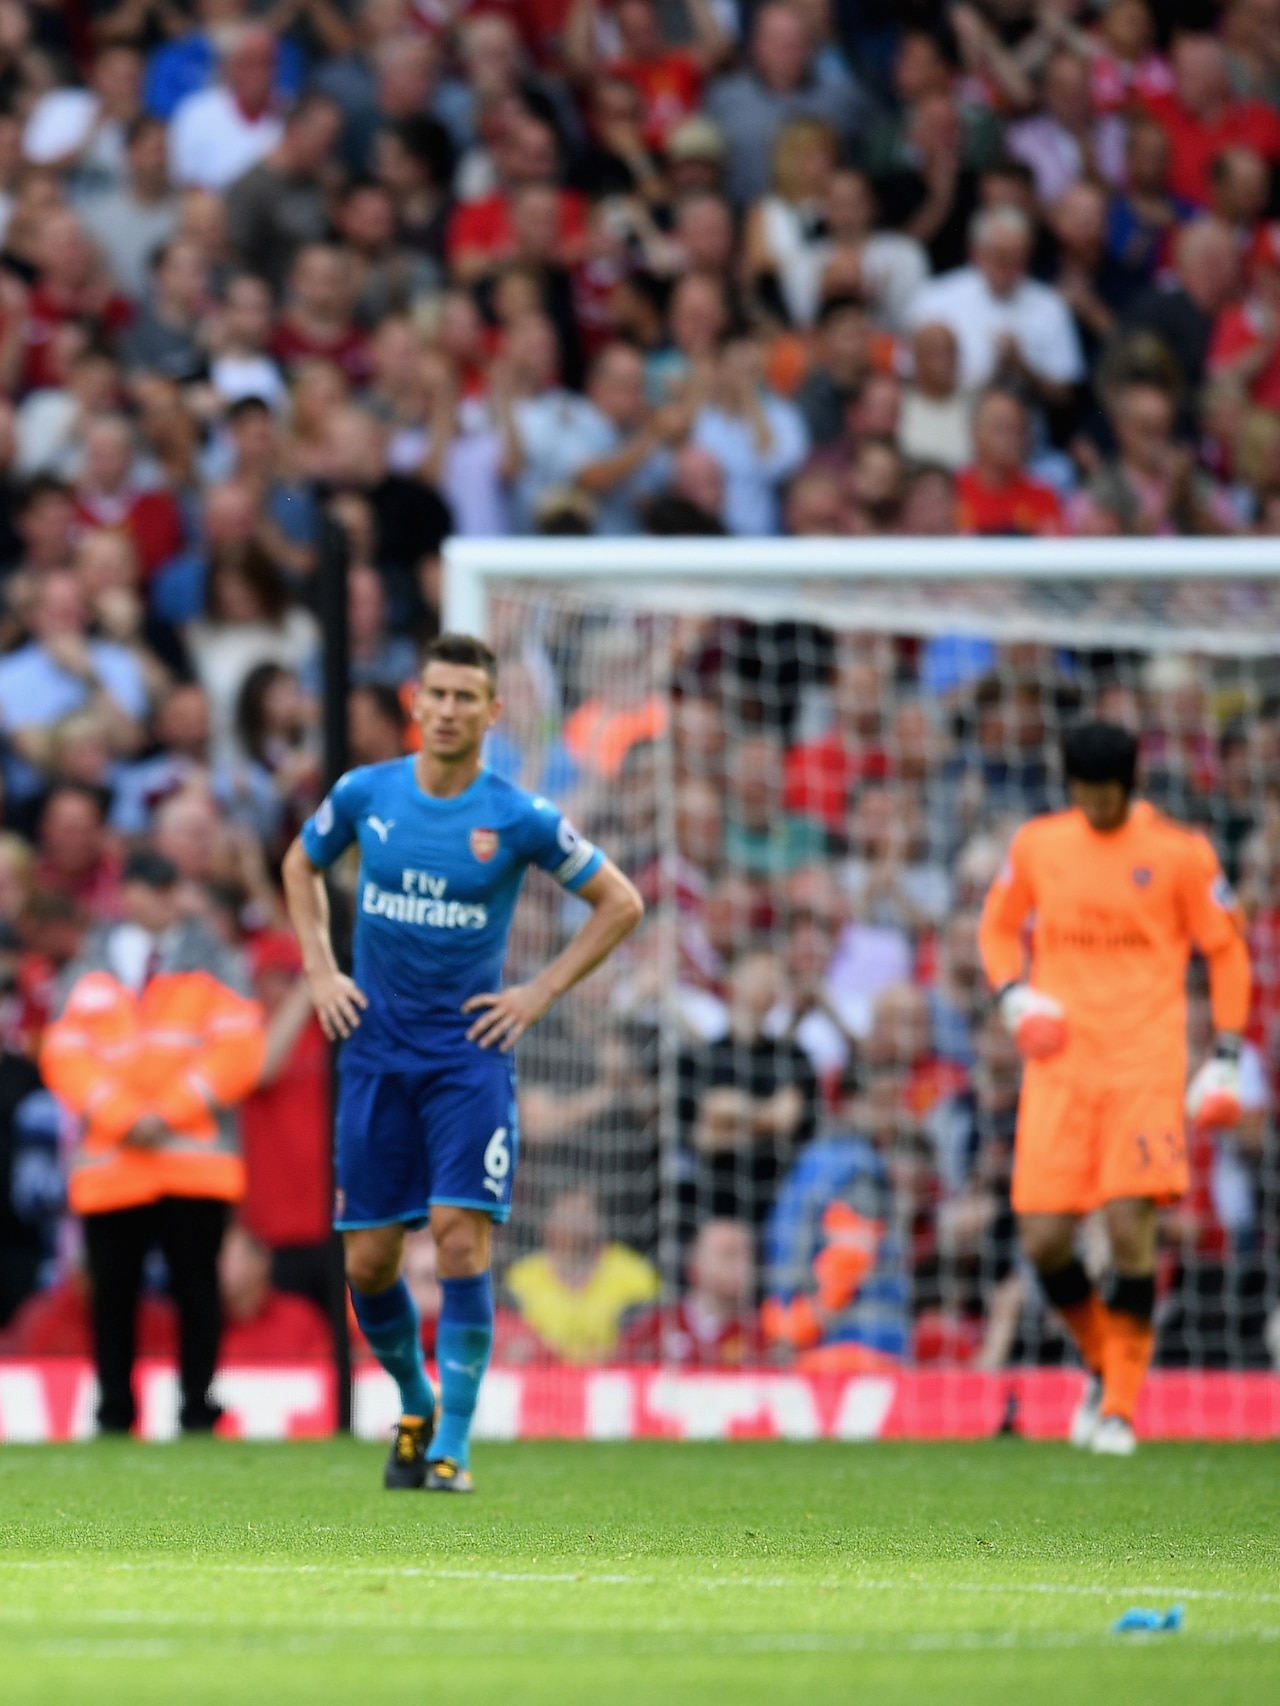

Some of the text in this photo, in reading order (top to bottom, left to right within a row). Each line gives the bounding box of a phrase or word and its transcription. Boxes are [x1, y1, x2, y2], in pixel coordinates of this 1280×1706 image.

[362, 881, 488, 930] Emirates
[402, 867, 448, 900] Fly
[484, 1126, 510, 1180] 6
